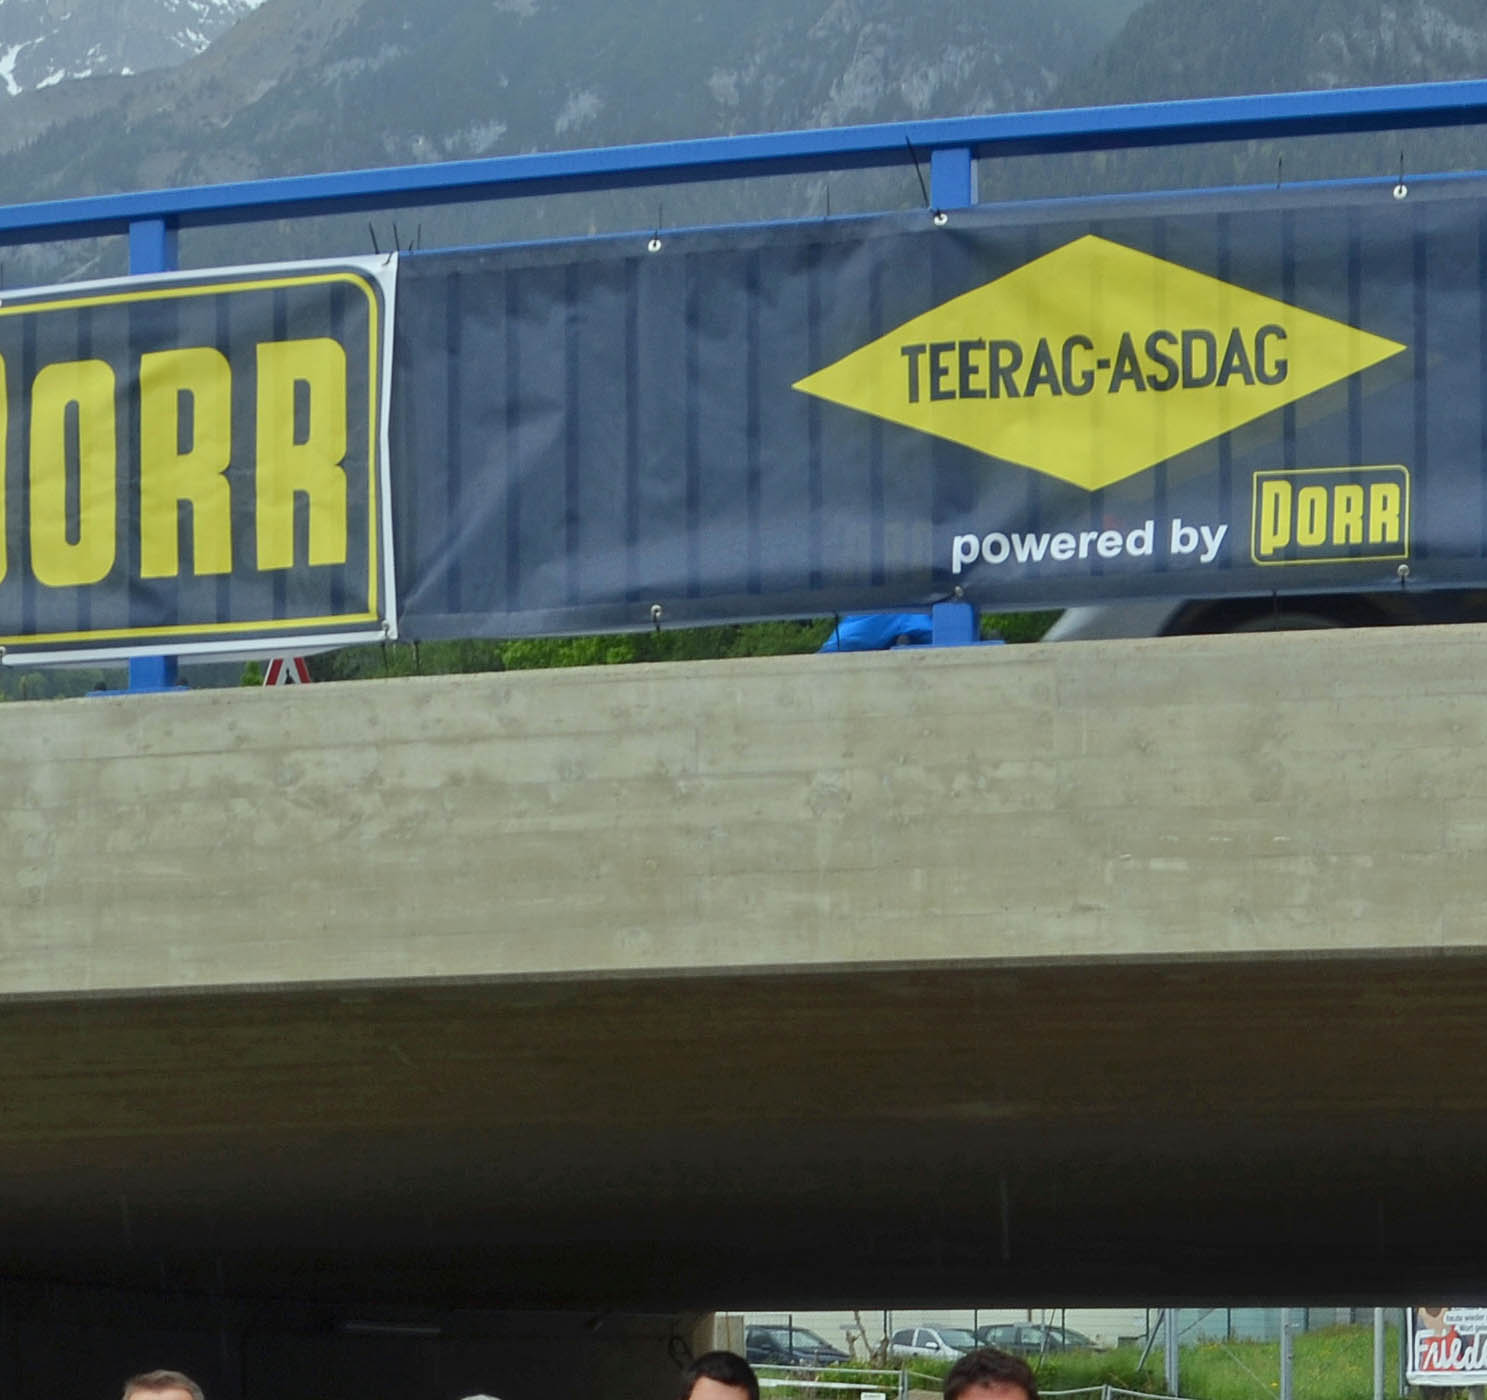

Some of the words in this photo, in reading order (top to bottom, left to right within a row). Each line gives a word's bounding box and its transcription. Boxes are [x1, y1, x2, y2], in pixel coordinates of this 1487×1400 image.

[900, 324, 1289, 404] TEERAG-ASDAG
[952, 520, 1155, 574] powered
[1170, 518, 1229, 563] by
[1260, 479, 1402, 556] PORR
